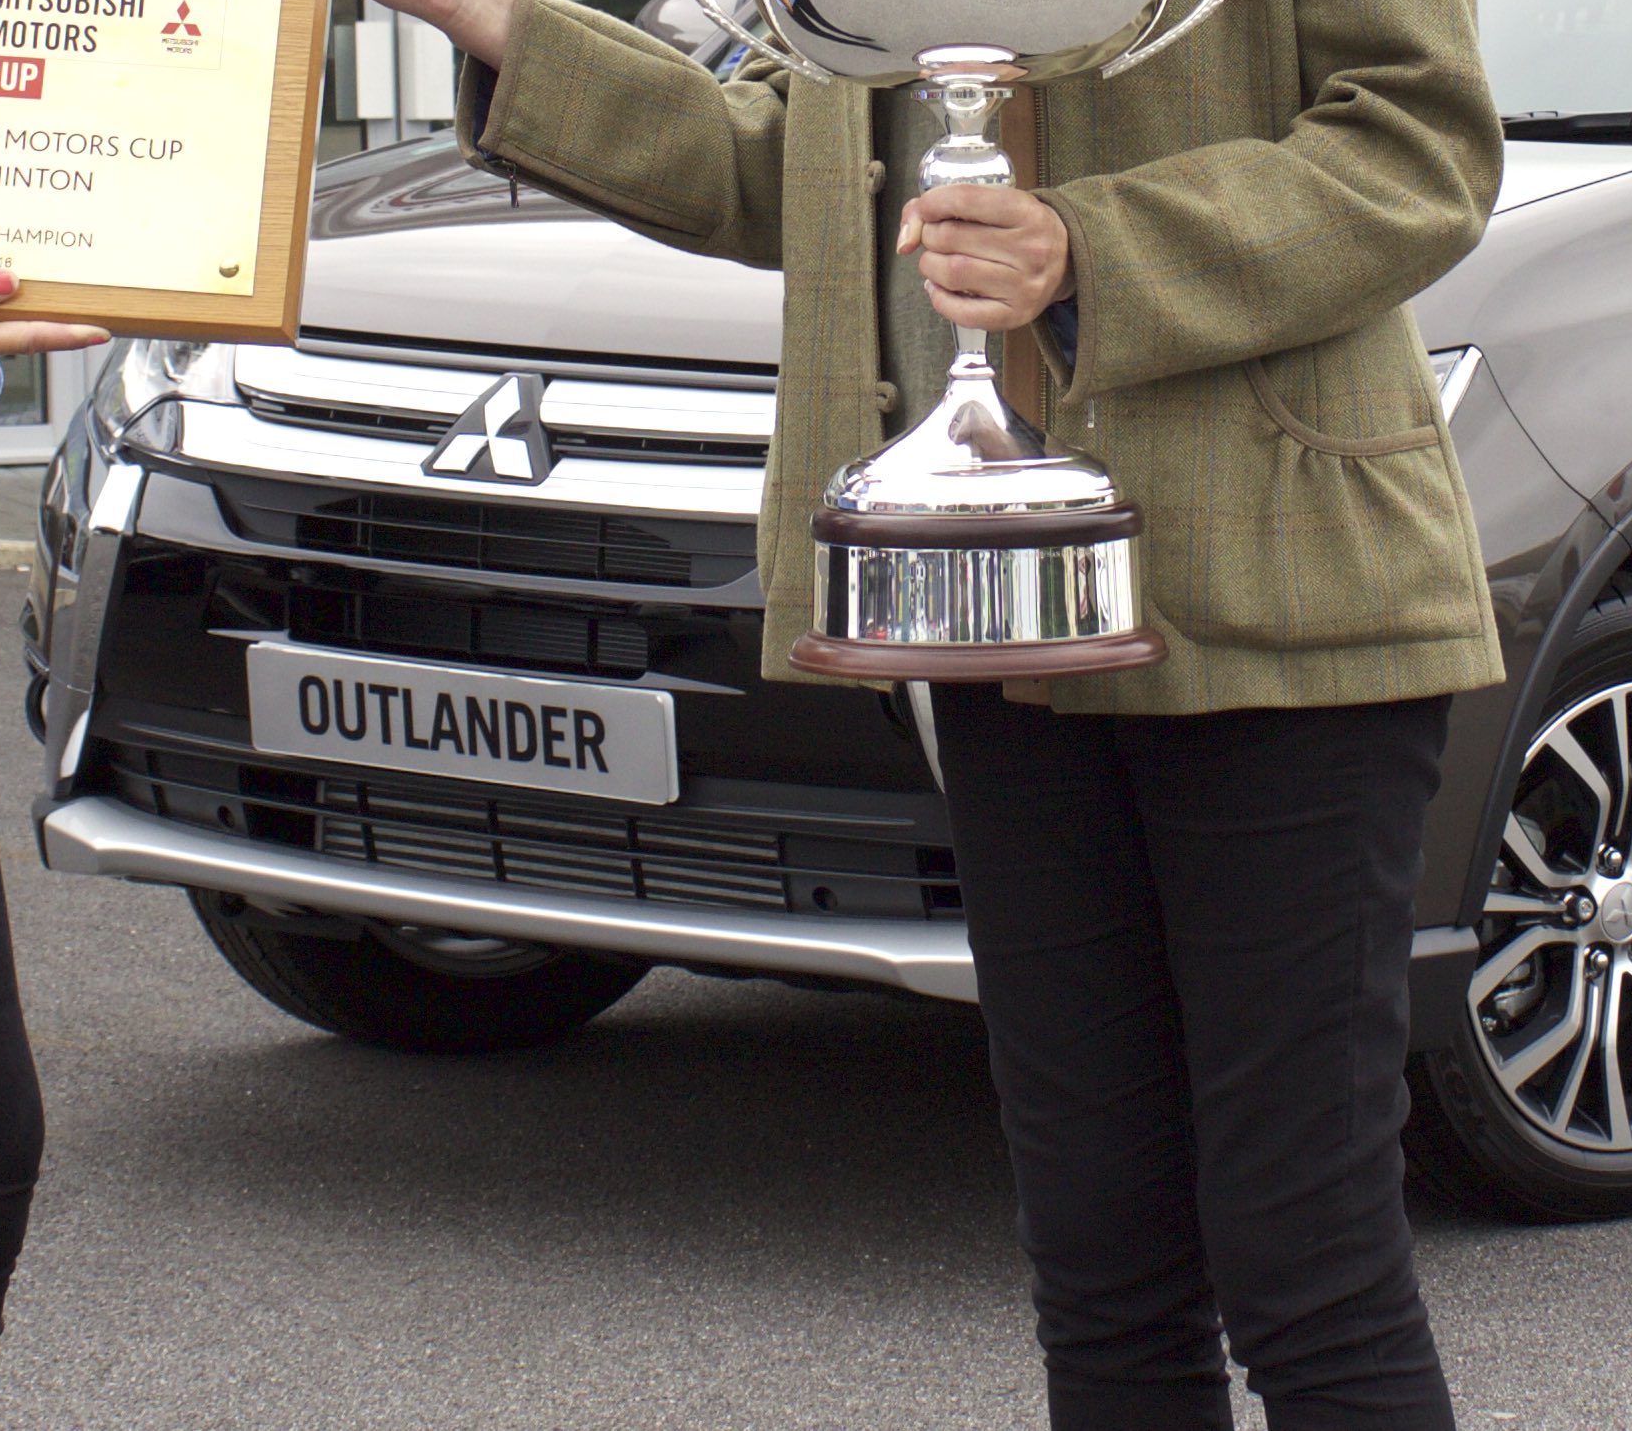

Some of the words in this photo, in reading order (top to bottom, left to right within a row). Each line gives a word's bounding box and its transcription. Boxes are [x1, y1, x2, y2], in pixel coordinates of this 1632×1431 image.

[4, 128, 120, 158] MOTORS
[129, 136, 184, 161] CUP
[297, 672, 610, 776] OUTLANDER
